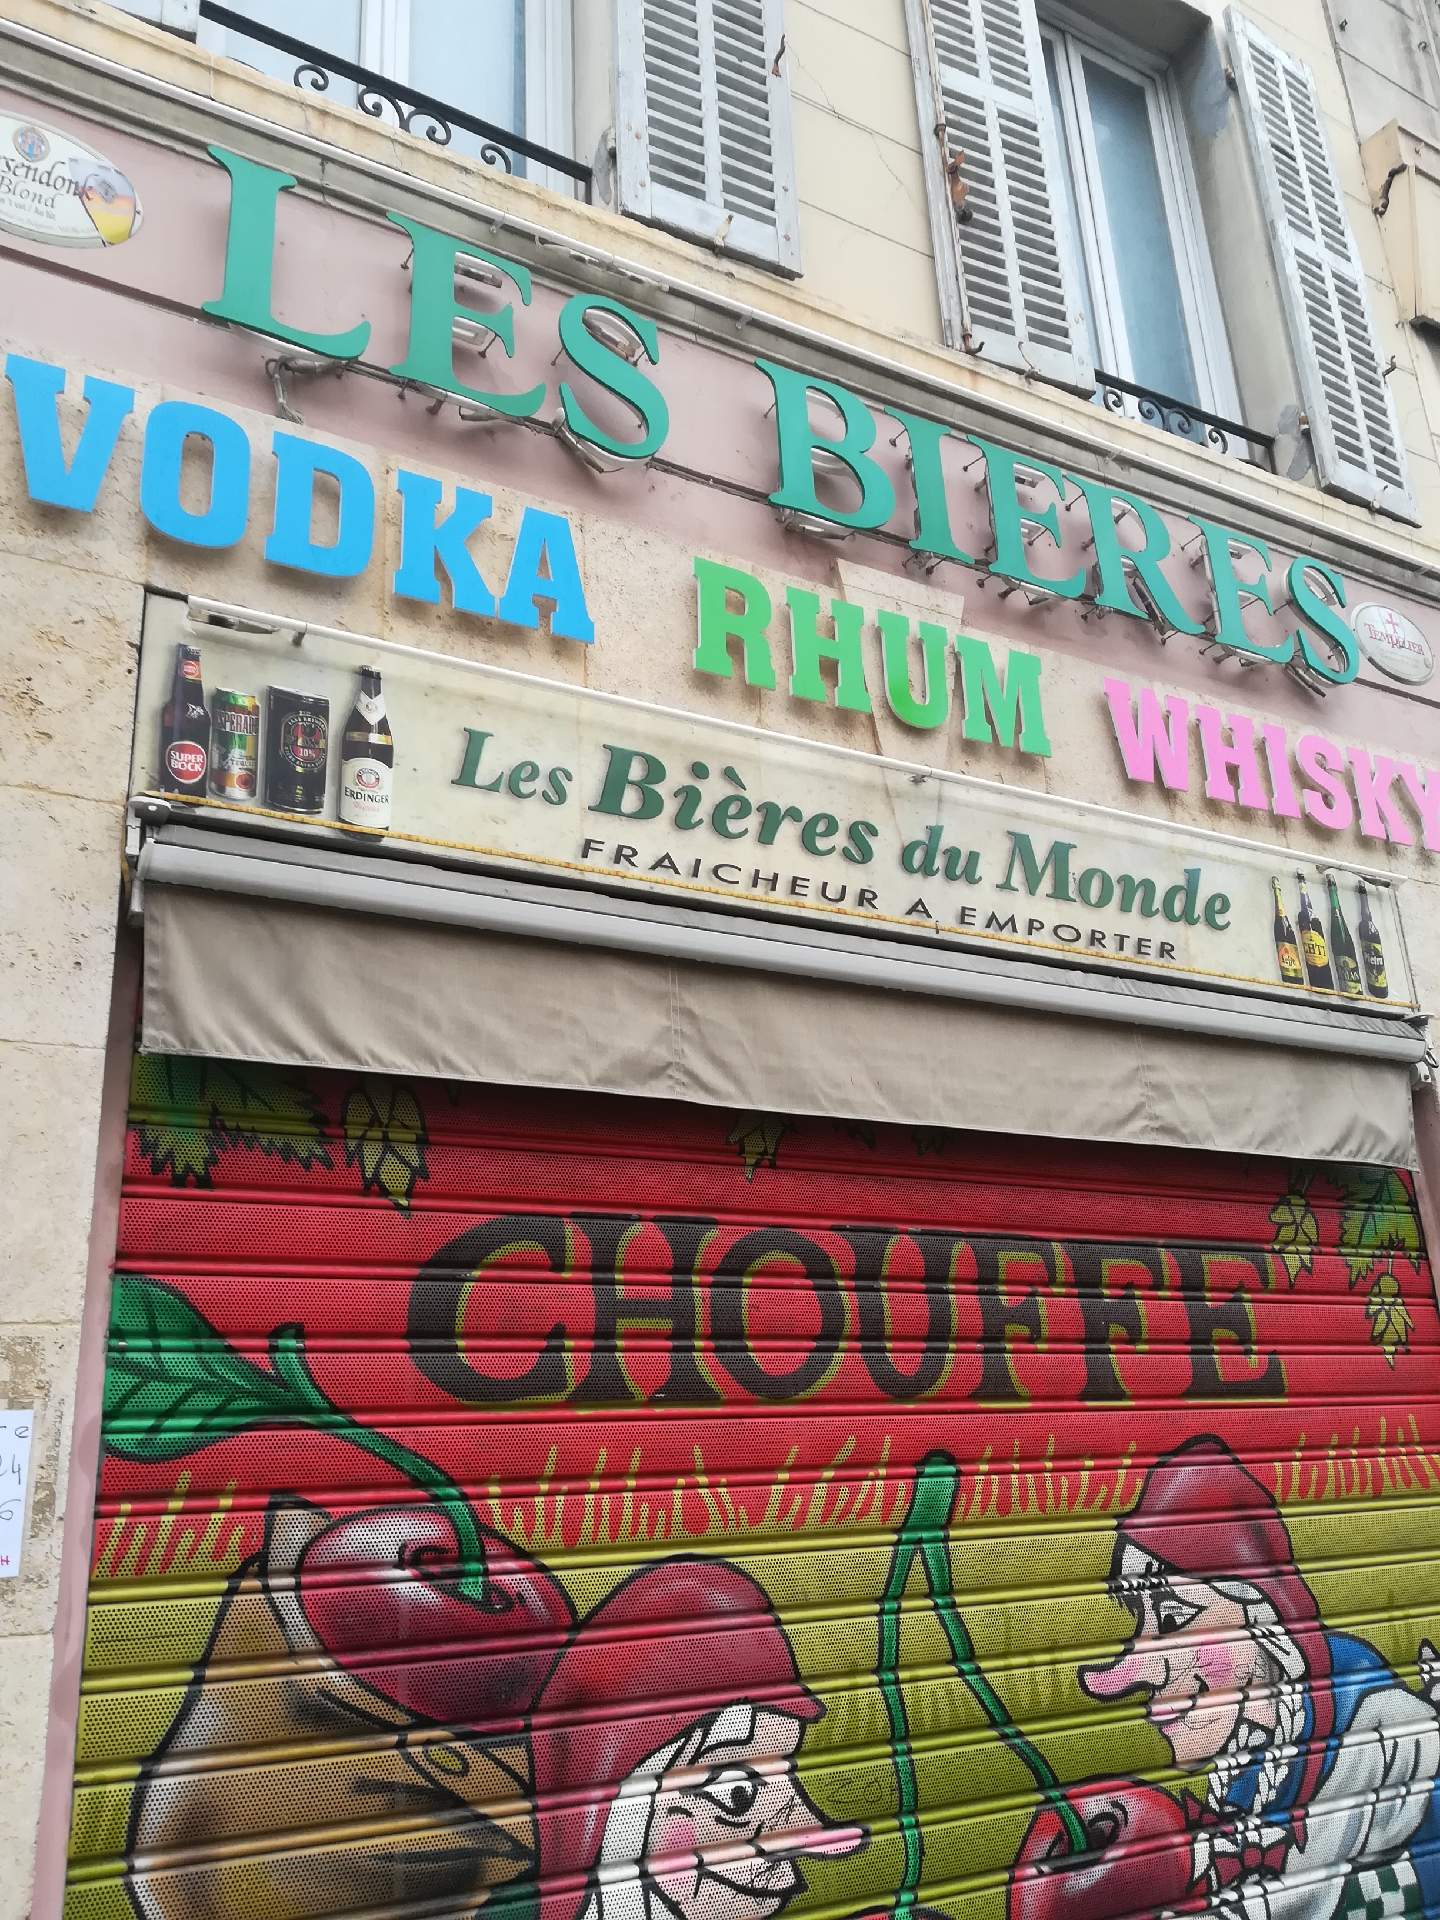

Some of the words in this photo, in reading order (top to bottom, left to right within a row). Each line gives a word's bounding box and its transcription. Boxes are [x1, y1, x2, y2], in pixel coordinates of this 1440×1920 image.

[0, 155, 98, 202] sendonk
[201, 144, 670, 461] LES
[754, 357, 1360, 685] BIERES
[4, 353, 595, 645] VODKA
[692, 556, 1053, 758] RHUM
[1103, 676, 1440, 853] WHISKY
[170, 750, 205, 763] SUPER
[170, 758, 203, 772] BOCK
[344, 785, 390, 804] ERDINGER
[450, 727, 574, 806] Les
[587, 743, 880, 865] Bières
[901, 824, 983, 885] du
[995, 829, 1232, 931] Monde
[580, 837, 880, 910] FRAICHEUR
[904, 897, 933, 920] A
[959, 905, 1177, 961] EMPORTER
[407, 1211, 1289, 1411] CHOUFFE
